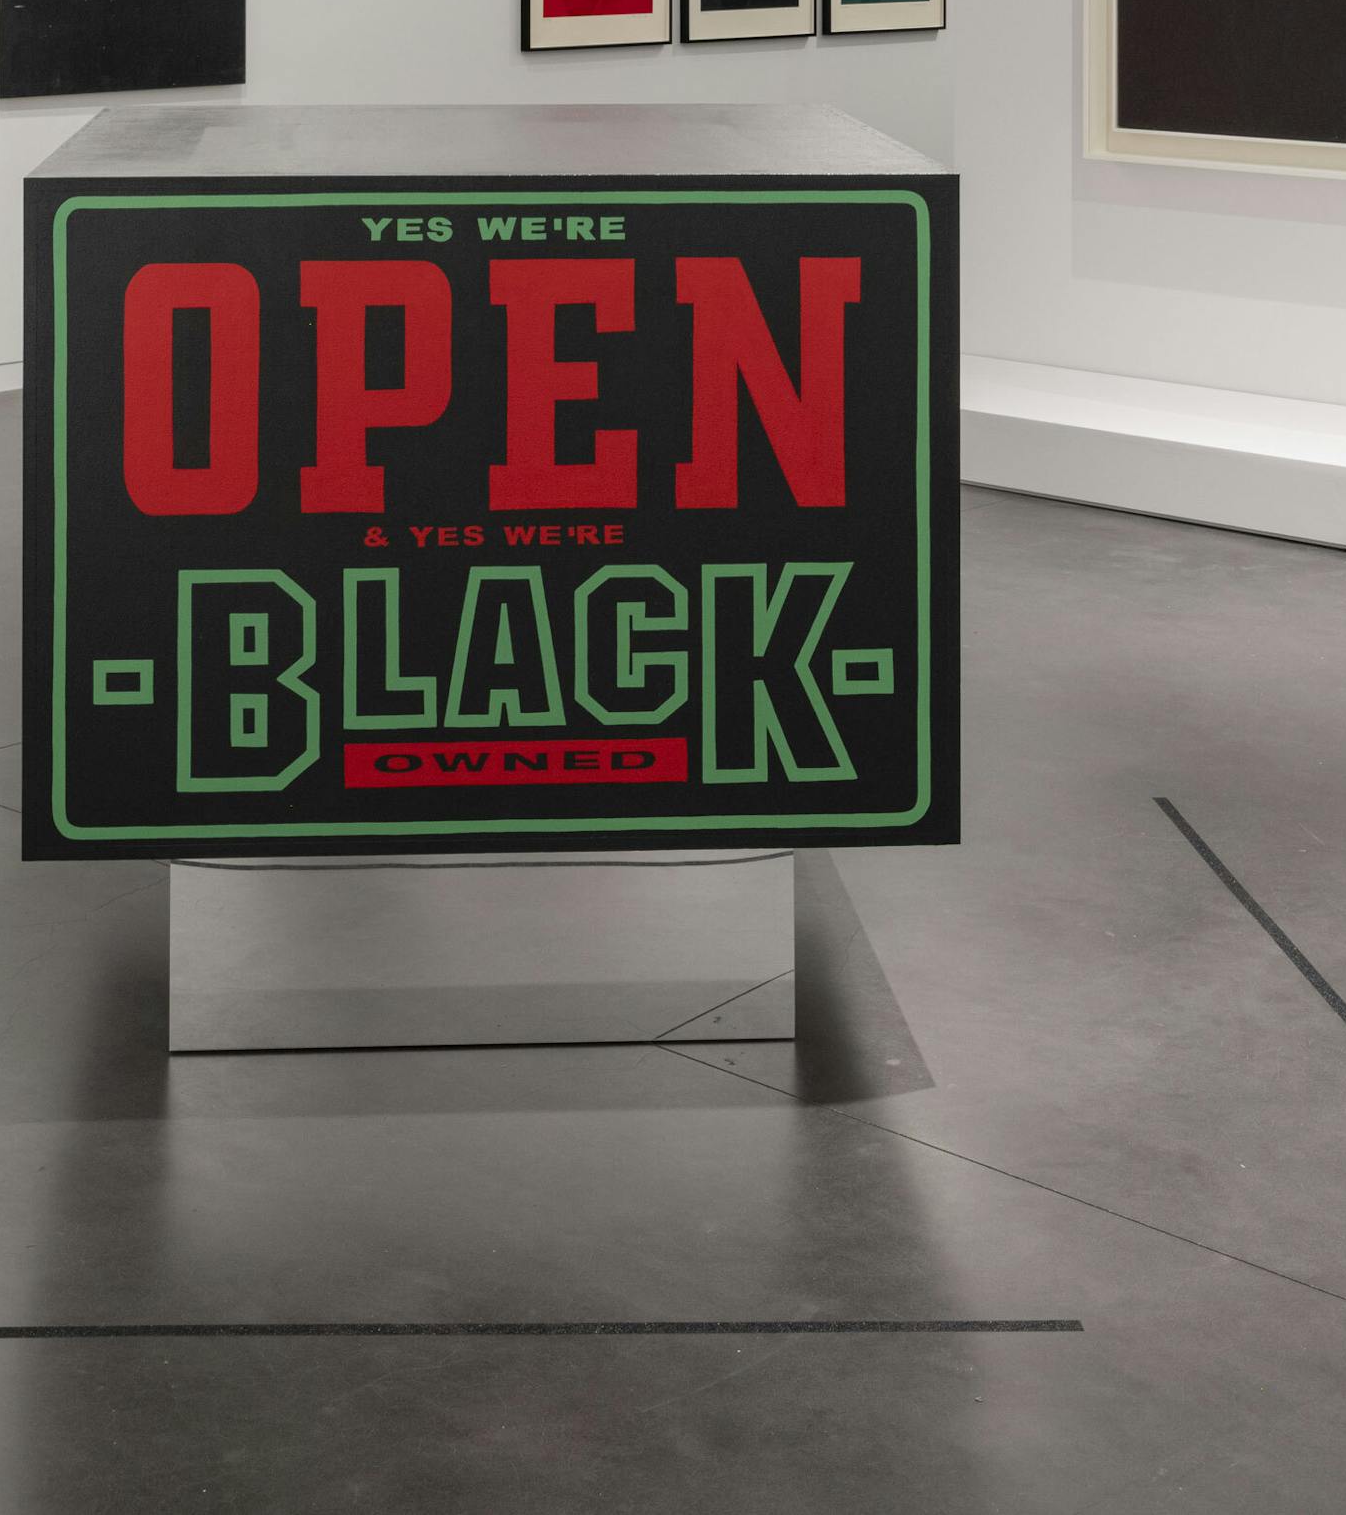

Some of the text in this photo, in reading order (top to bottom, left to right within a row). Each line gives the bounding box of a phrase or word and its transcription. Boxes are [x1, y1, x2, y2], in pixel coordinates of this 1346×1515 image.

[361, 217, 626, 243] YES WE'RE
[123, 256, 862, 516] OPEN
[363, 524, 624, 548] & YES WE'RE
[373, 750, 658, 774] OWNED
